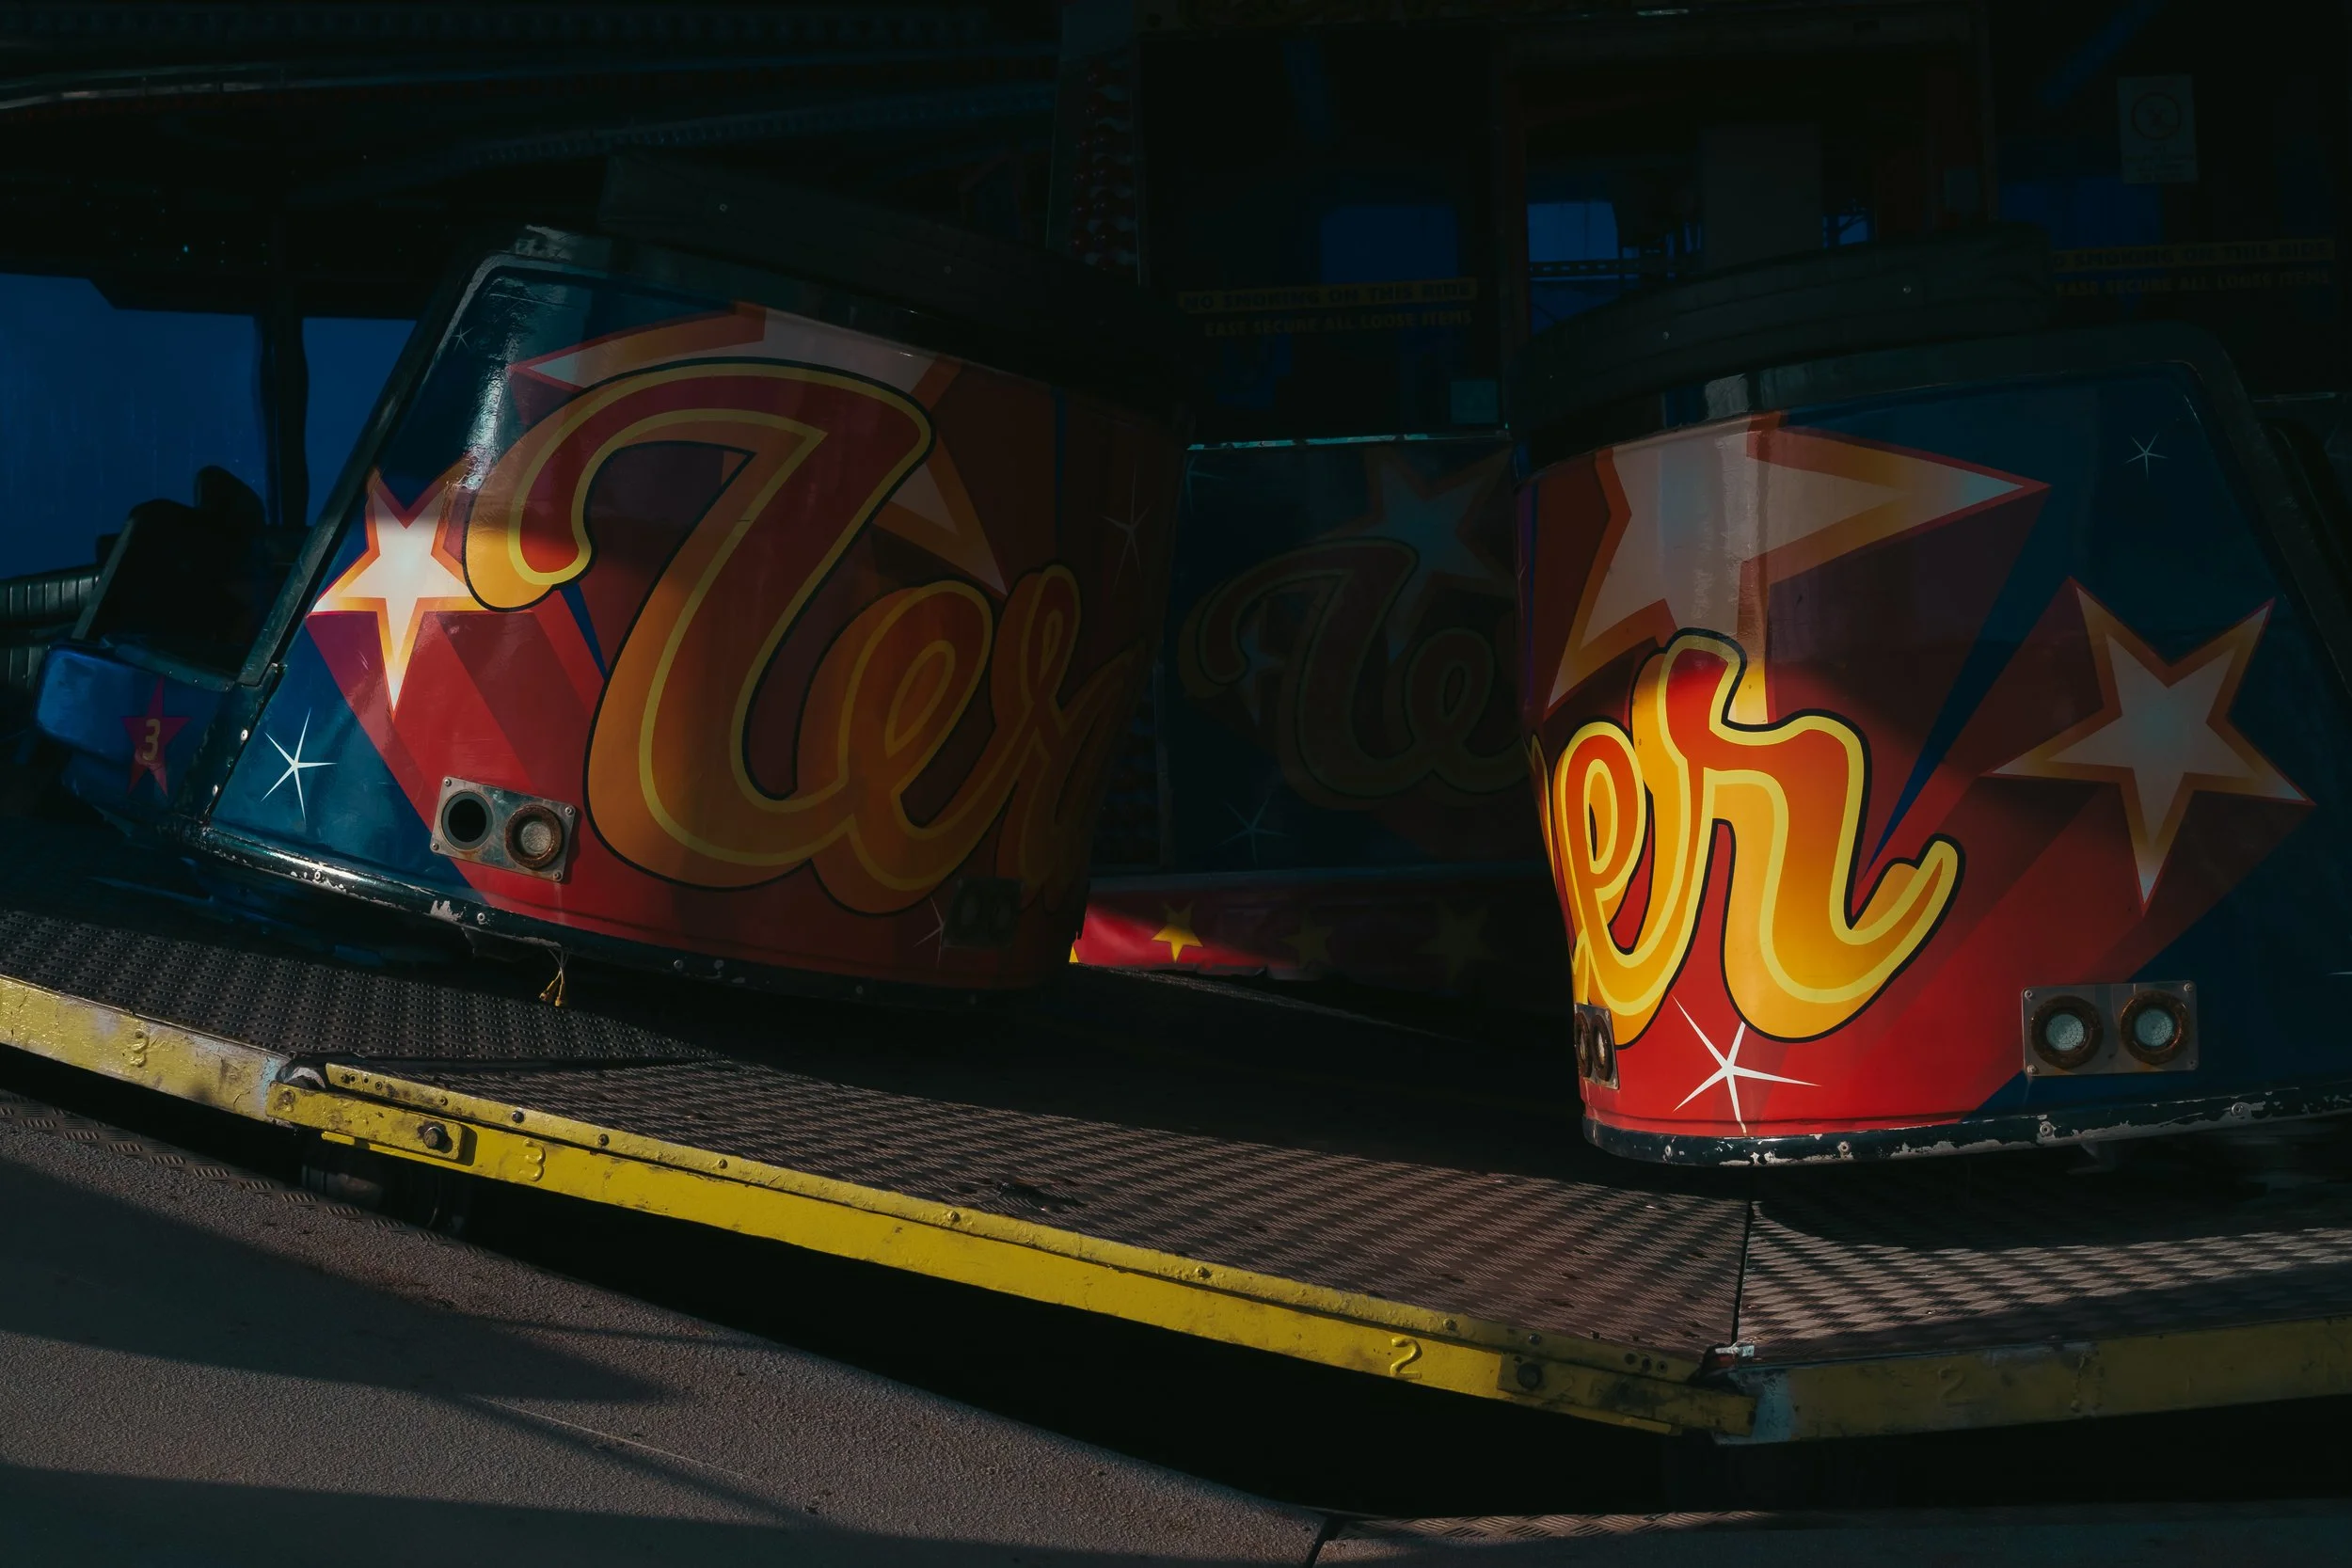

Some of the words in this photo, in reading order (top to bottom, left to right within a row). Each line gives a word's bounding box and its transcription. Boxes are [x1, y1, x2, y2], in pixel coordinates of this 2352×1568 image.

[2074, 248, 2174, 267] SMOKING
[2185, 247, 2217, 262] ON
[2223, 244, 2269, 260] THIS
[2279, 241, 2329, 257] RIDE
[1183, 294, 1214, 310] NO
[1223, 290, 1320, 309] SMOKING
[1329, 288, 1358, 302] ON
[1368, 283, 1415, 300] THIS
[1421, 281, 1472, 299] RIDE
[2105, 277, 2173, 296] SECURE
[2178, 275, 2212, 293] ALL
[2217, 272, 2273, 291] LOOSE
[2278, 268, 2332, 288] ITEMS
[1254, 316, 1317, 337] SECURE
[1324, 314, 1357, 332] ALL
[1360, 310, 1418, 329] LOOSE
[1421, 309, 1474, 326] ITEMS
[140, 718, 161, 762] 3
[126, 1028, 150, 1069] 3
[520, 1137, 547, 1183] 3
[1390, 1336, 1423, 1381] 2
[1938, 1364, 1979, 1408] 2
